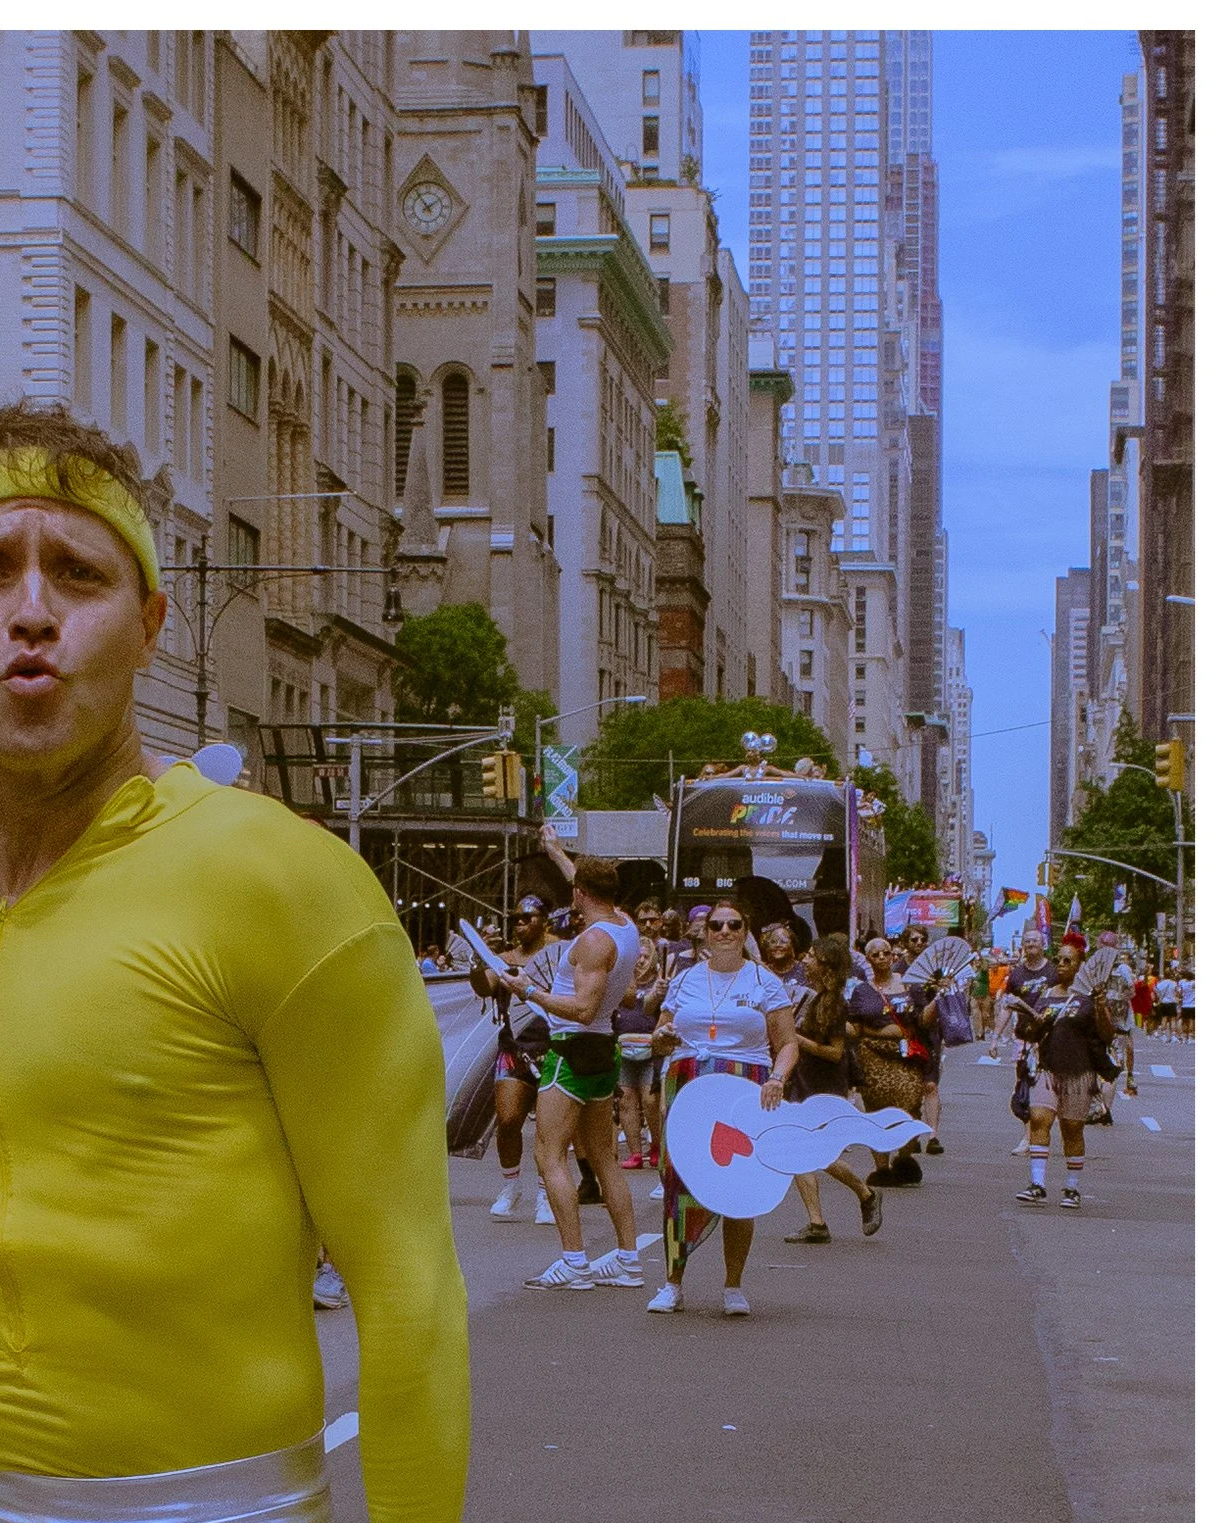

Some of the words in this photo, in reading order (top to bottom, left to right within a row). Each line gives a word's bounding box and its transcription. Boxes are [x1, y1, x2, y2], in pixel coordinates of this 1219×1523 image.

[742, 793, 784, 805] audible
[692, 827, 739, 839] Celebrating
[782, 830, 798, 840] that
[799, 831, 822, 841] move
[823, 833, 835, 842] us
[683, 877, 700, 888] 188
